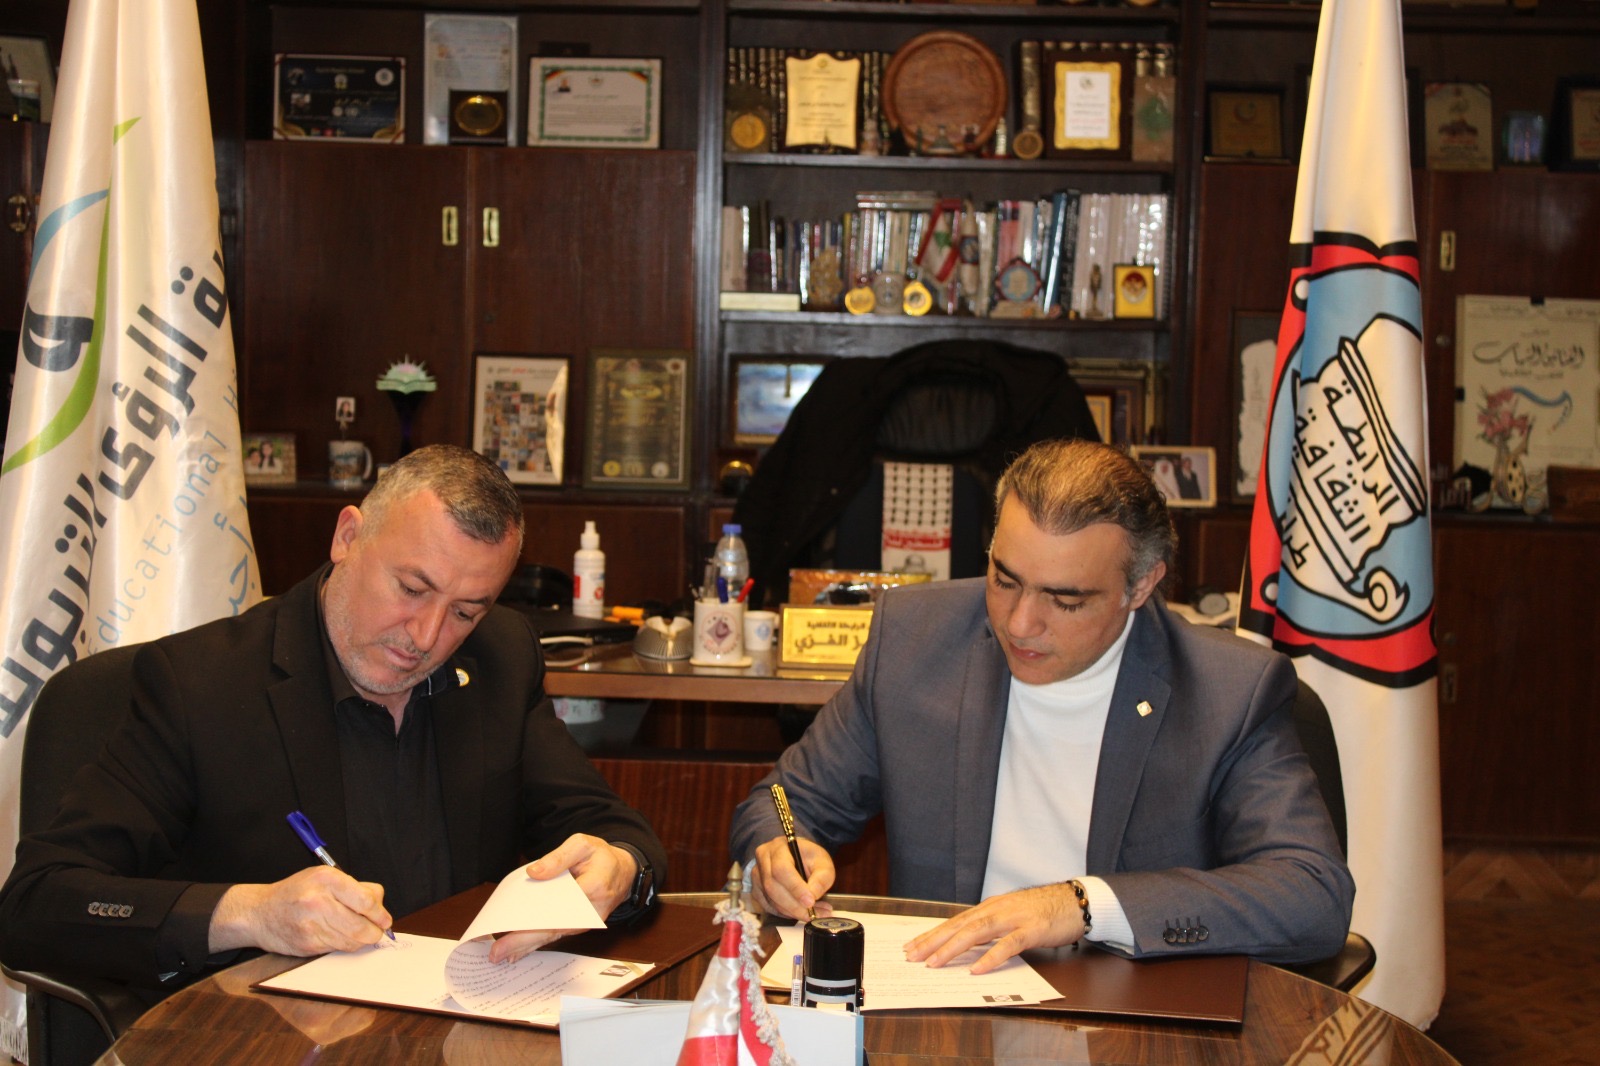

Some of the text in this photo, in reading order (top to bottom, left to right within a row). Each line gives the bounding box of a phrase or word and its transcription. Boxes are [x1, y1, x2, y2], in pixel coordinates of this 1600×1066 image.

[98, 303, 208, 501] الرؤى
[1322, 378, 1401, 516] الرابطة
[1292, 407, 1371, 544] الثقافية
